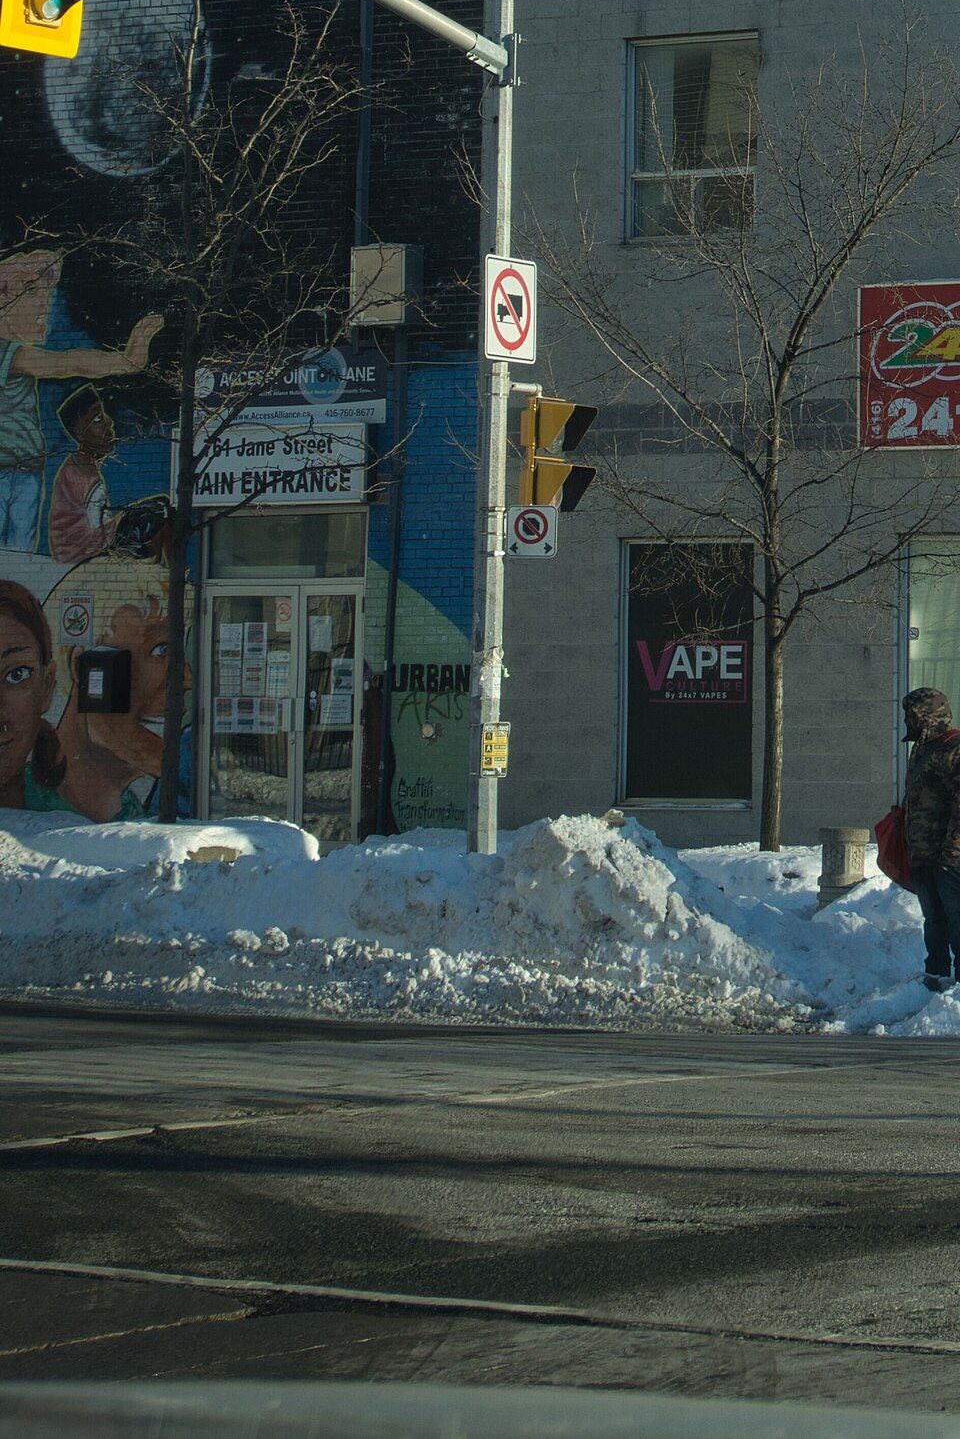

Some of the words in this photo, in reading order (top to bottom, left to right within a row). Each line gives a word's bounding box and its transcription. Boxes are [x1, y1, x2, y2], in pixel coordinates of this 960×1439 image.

[324, 408, 375, 418] 416-760-8677
[236, 438, 275, 458] Jane
[282, 434, 333, 456] Street
[240, 467, 352, 495] ENTRANCE
[636, 640, 743, 691] VAPE
[391, 663, 472, 693] URBAN
[666, 682, 743, 692] CULTURE
[665, 691, 675, 700] By
[678, 691, 697, 699] 24x7
[700, 691, 727, 699] VAPES
[397, 691, 467, 728] ARTS
[397, 776, 434, 798] Graffiti
[394, 798, 467, 823] Transformation
